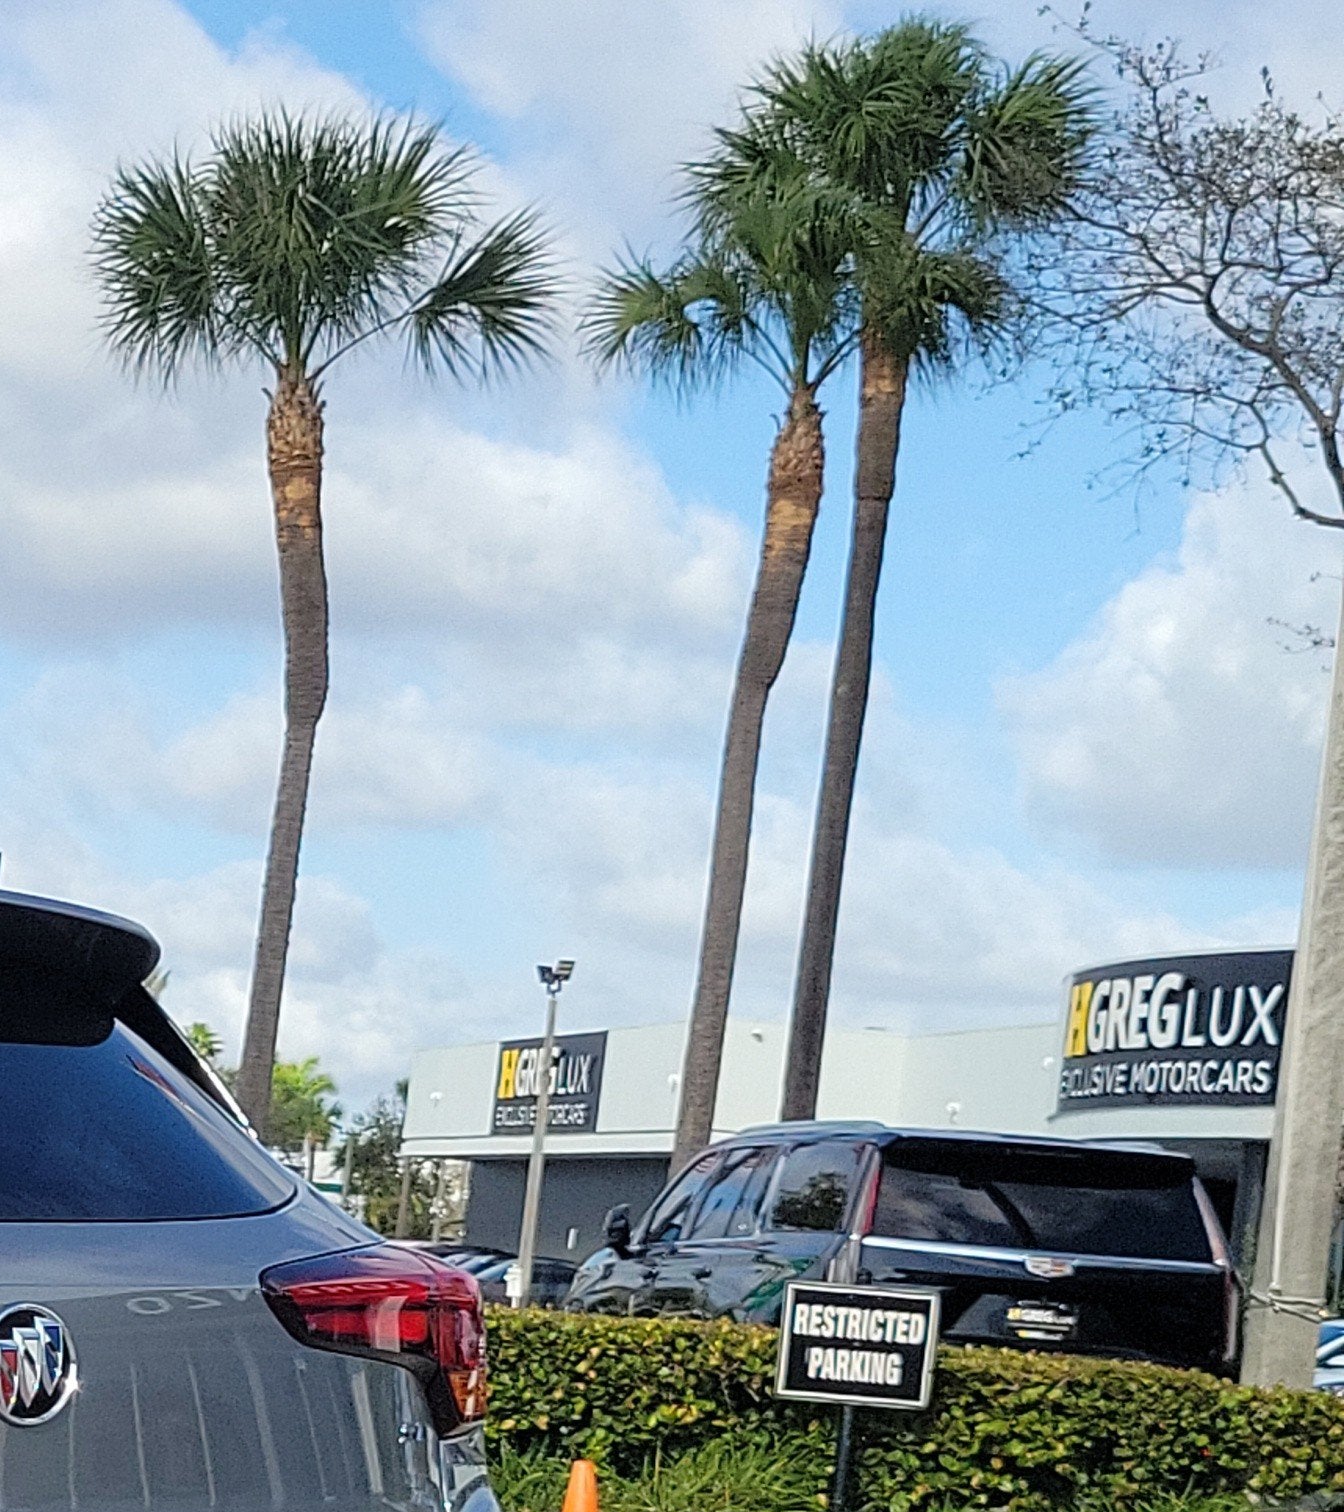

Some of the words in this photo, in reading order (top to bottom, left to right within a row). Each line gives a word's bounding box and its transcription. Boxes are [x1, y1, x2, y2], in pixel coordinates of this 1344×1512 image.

[1129, 1058, 1272, 1094] MOTORCARS
[793, 1303, 926, 1345] RESTRICTED
[807, 1347, 903, 1386] PARKING
